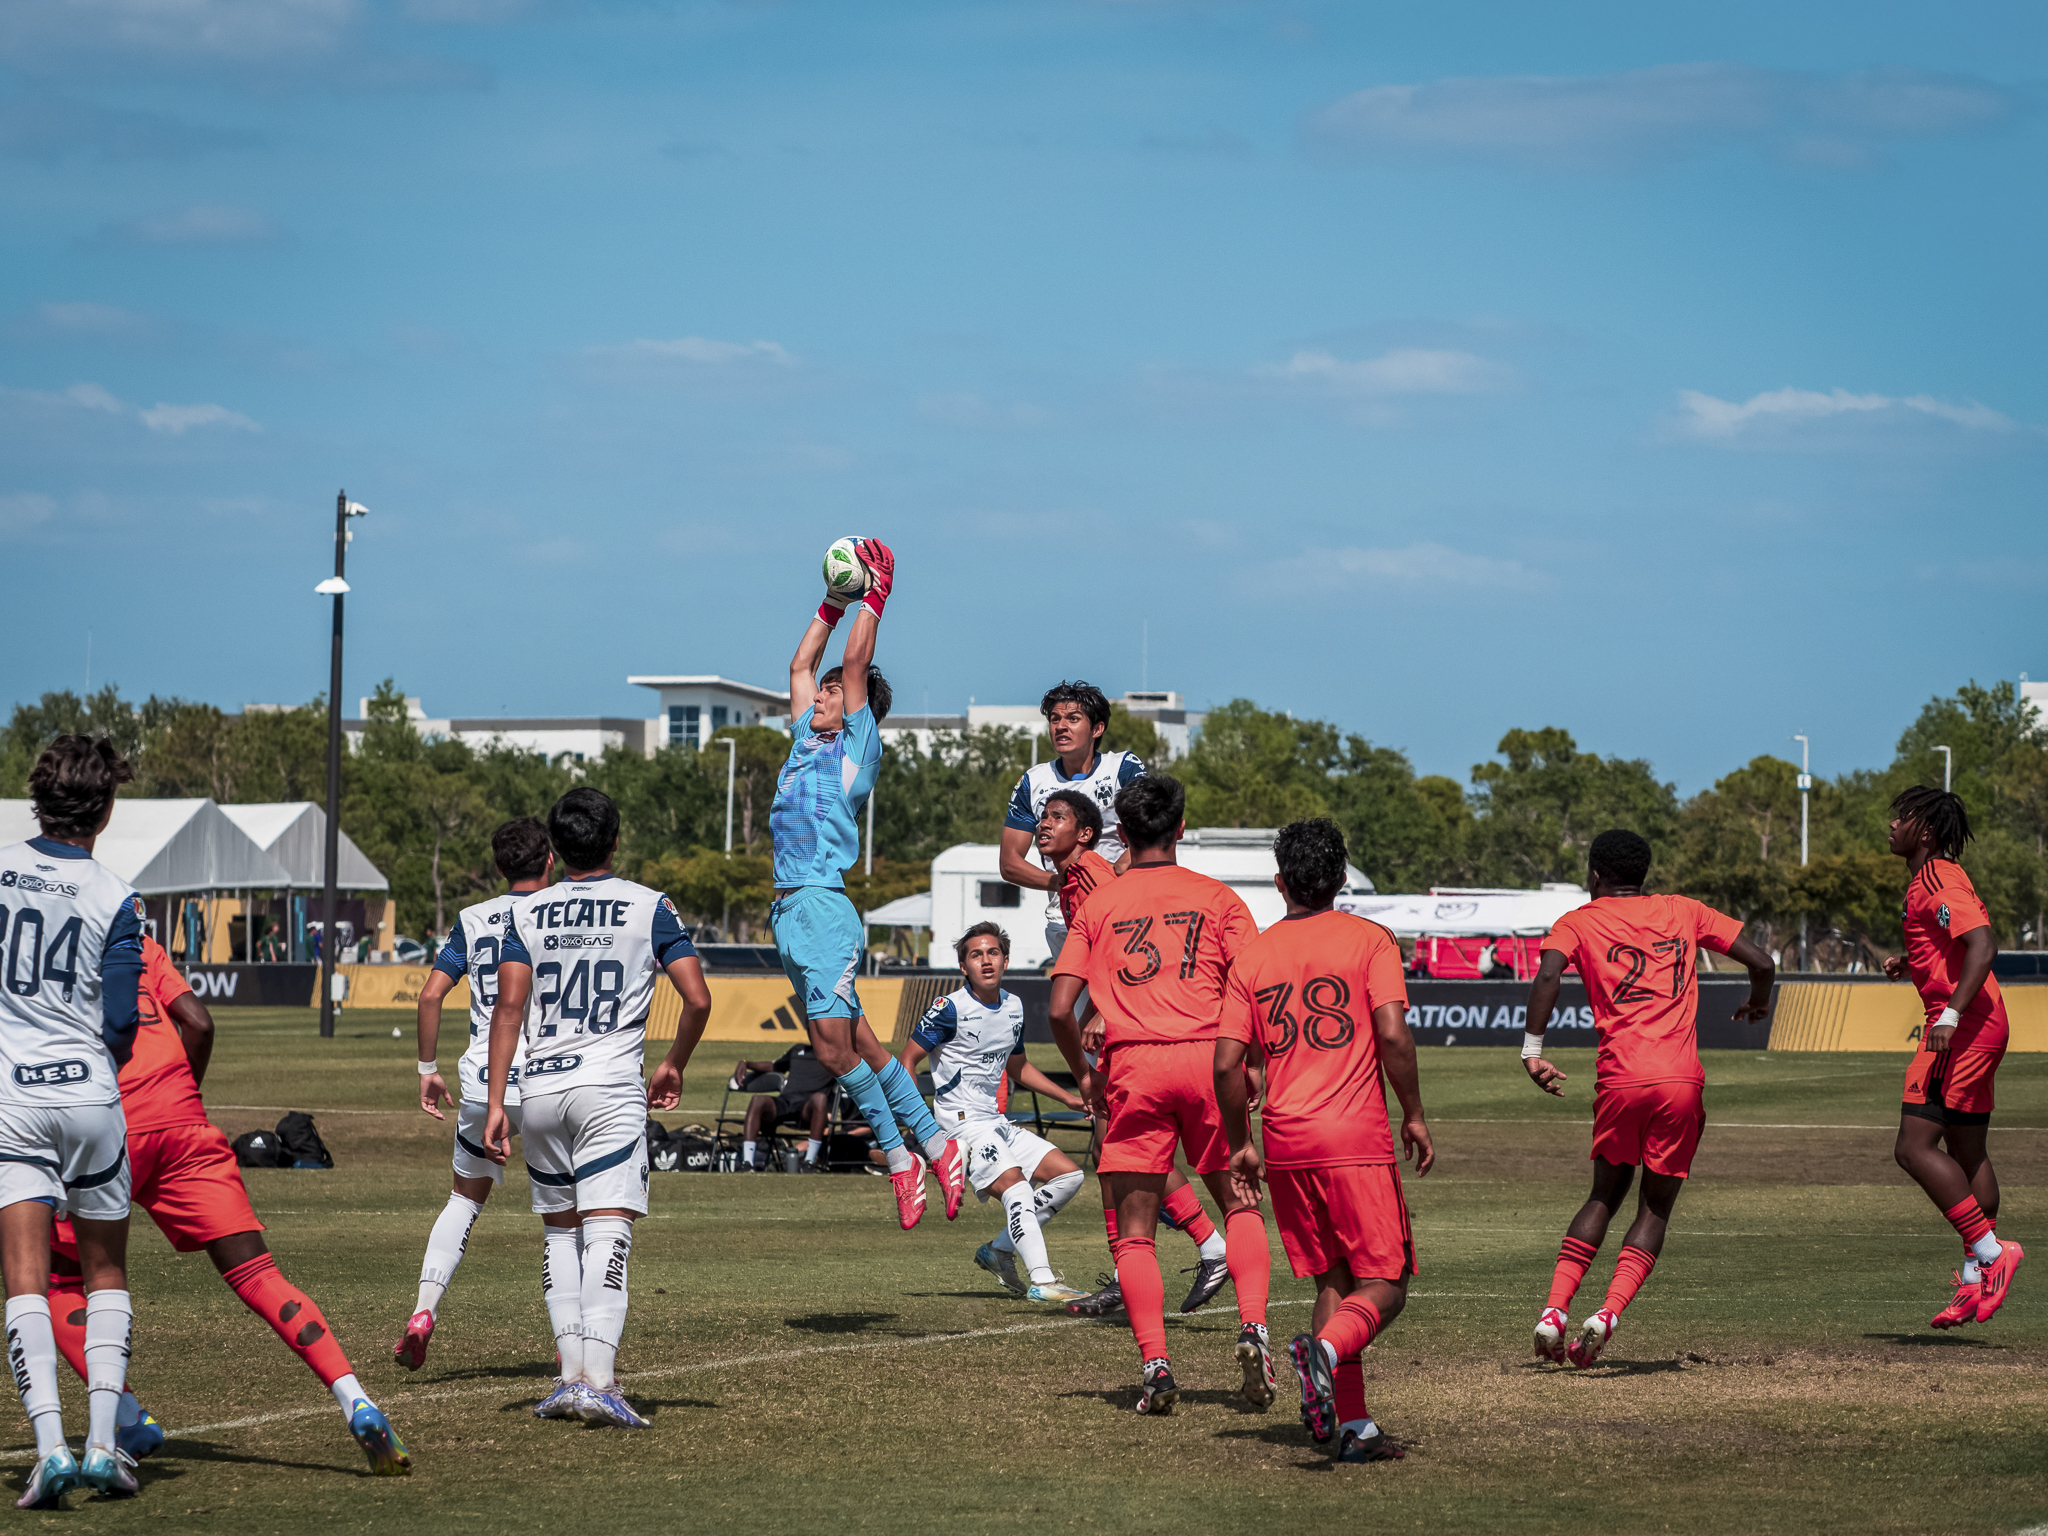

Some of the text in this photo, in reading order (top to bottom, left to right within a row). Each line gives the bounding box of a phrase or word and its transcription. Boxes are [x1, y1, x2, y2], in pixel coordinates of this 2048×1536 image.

[529, 898, 631, 930] TECATE
[583, 937, 612, 946] GAS
[1111, 910, 1206, 987] 37
[0, 904, 84, 1004] 04
[1606, 937, 1687, 1005] 27
[536, 959, 625, 1038] 248
[1254, 973, 1355, 1059] 38
[1490, 1004, 1594, 1029] ADDAS
